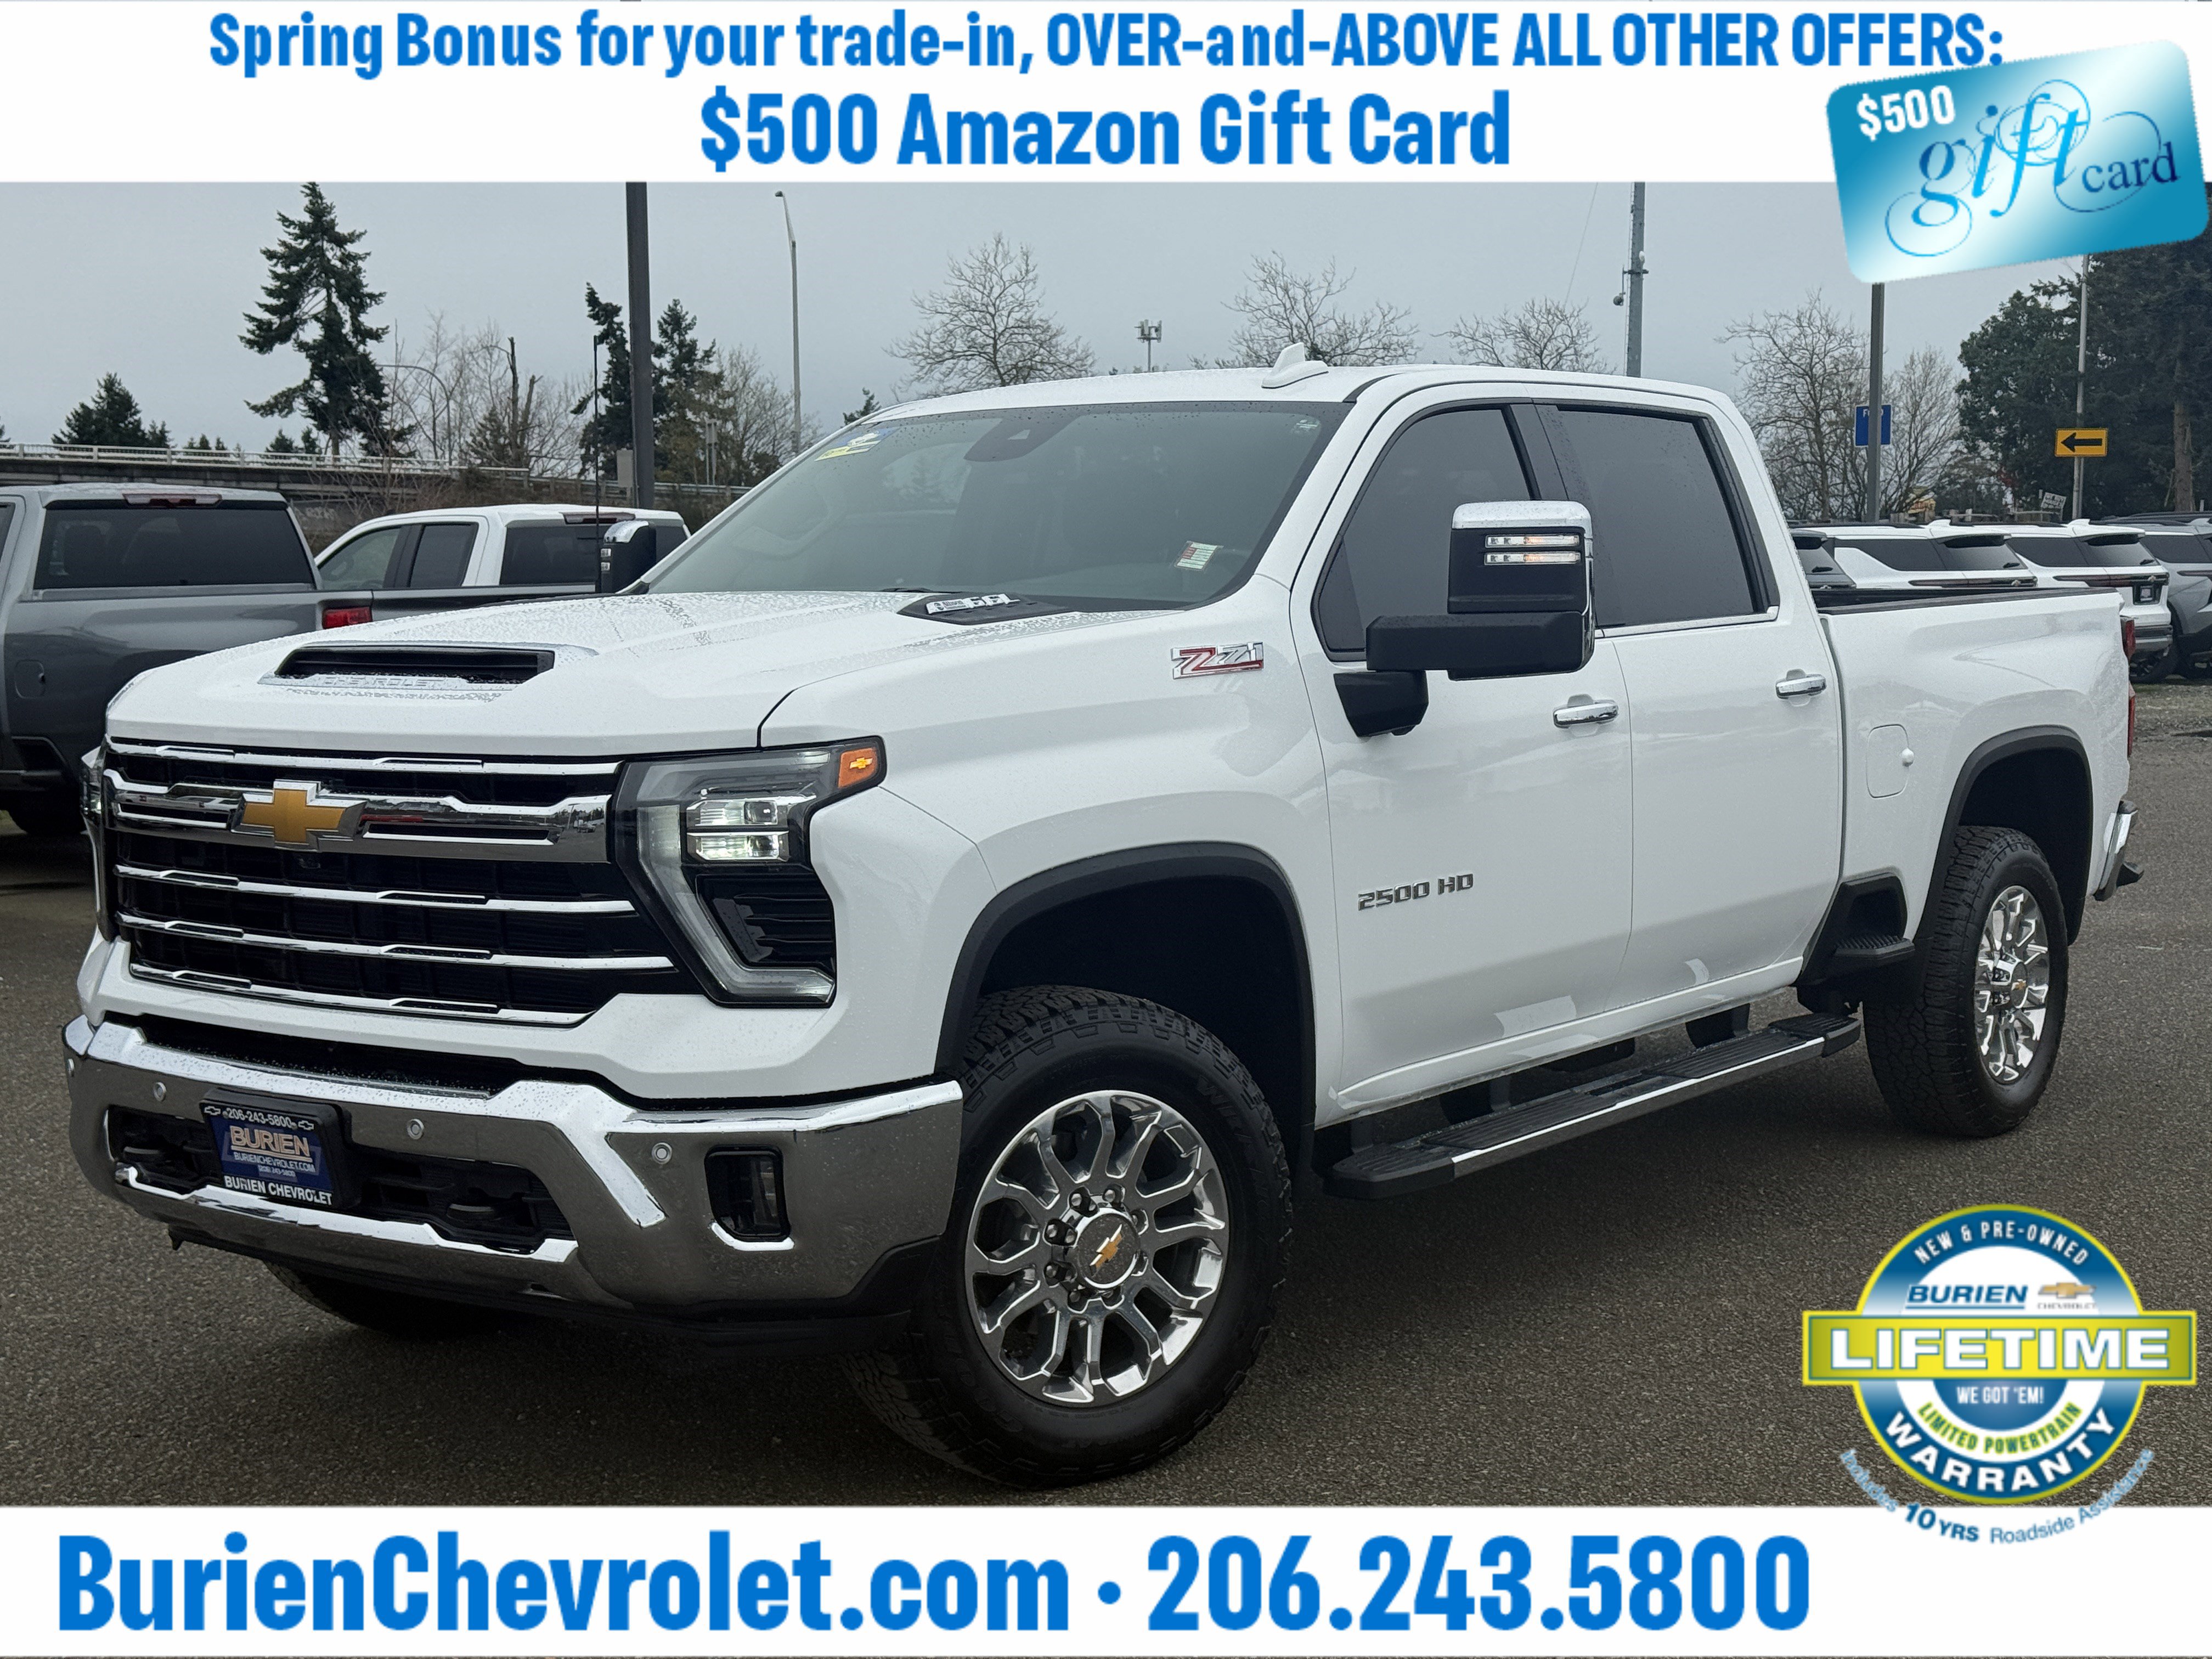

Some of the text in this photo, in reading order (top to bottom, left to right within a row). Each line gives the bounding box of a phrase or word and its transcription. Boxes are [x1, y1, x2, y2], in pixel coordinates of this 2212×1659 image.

[1171, 641, 1264, 680] Z71
[1358, 873, 1474, 911] 2500 HD
[227, 1108, 294, 1128] 206-243-5800
[230, 1126, 311, 1157] BURIEN
[224, 1176, 332, 1205] BURIEN CHEVROLET
